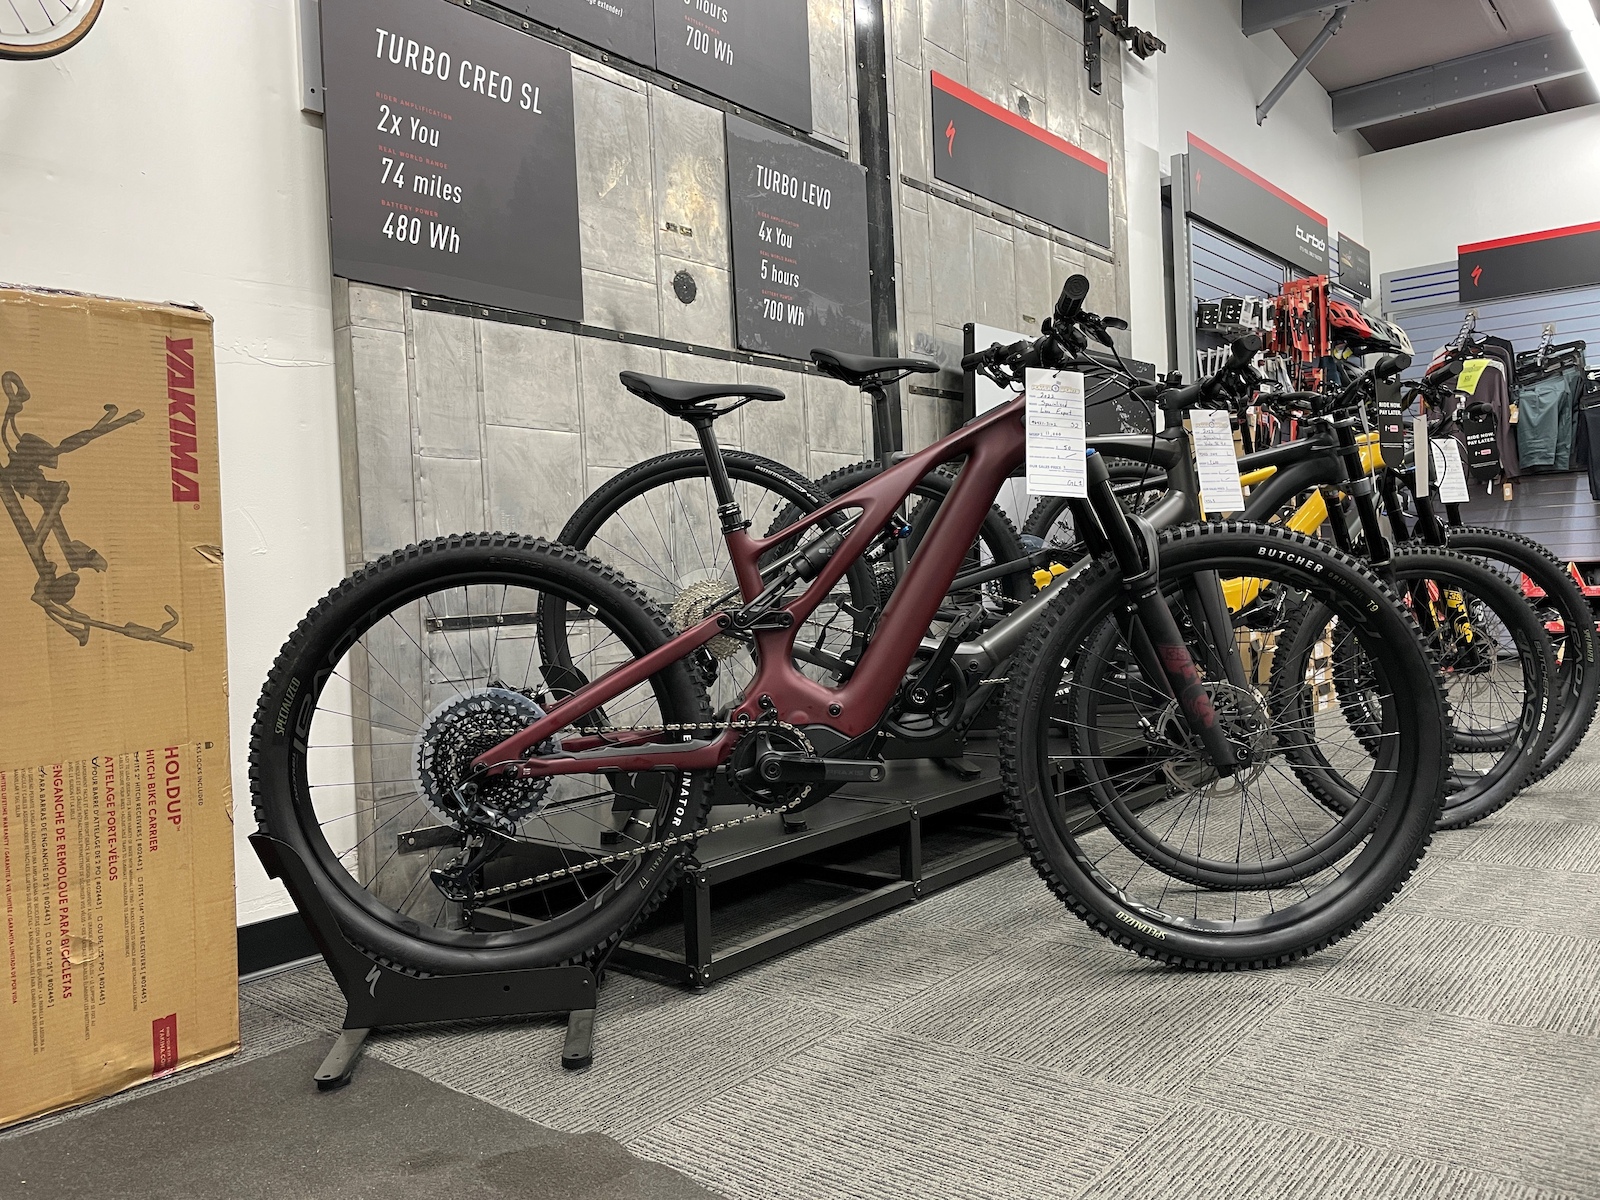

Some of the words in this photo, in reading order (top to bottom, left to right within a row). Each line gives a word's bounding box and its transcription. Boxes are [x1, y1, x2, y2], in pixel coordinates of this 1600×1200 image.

[597, 2, 623, 18] extender)
[686, 25, 709, 54] 700
[715, 38, 733, 65] Wh
[375, 28, 450, 81] TURBO
[459, 60, 513, 103] CREO
[520, 82, 542, 114] SL
[376, 91, 398, 104] RIDER
[400, 99, 452, 120] AMPLIFICATION
[377, 104, 402, 136] 2x
[410, 116, 440, 147] You
[378, 144, 397, 156] REAL
[400, 150, 423, 162] WORLD
[426, 158, 448, 169] RANGE
[381, 157, 404, 189] 74
[413, 174, 462, 204] miles
[757, 164, 798, 199] TURBO
[802, 181, 831, 210] LEVO
[381, 199, 412, 212] BATTERY
[415, 206, 439, 217] POWER
[383, 212, 422, 245] 480
[429, 221, 460, 253] Wh
[759, 220, 772, 242] 4x
[776, 227, 792, 248] You
[1296, 225, 1325, 251] turbo
[761, 259, 768, 279] 5
[772, 264, 799, 287] hours
[764, 299, 784, 322] 700
[788, 304, 804, 326] Wh
[1258, 547, 1323, 573] BUTCHER
[1534, 640, 1549, 696] BUTCHER
[274, 676, 300, 736] SPECIALIZED
[146, 749, 156, 780] HITCH
[52, 765, 65, 824] ENGANCHE
[105, 756, 115, 808] ATTELAGE
[147, 784, 156, 806] BIKE
[41, 822, 47, 831] DE
[56, 828, 66, 841] DE
[148, 809, 158, 852] CARRIER
[94, 851, 100, 859] DE
[106, 811, 119, 881] PORTE-VÉLOS
[43, 873, 49, 881] DE
[57, 845, 68, 904] REMOLQUE
[95, 866, 101, 875] PO
[59, 908, 69, 936] PARA
[97, 924, 103, 934] OU
[1116, 910, 1167, 940] SPECIALIZED
[60, 939, 72, 999] BICICLETAS
[99, 962, 105, 972] PO
